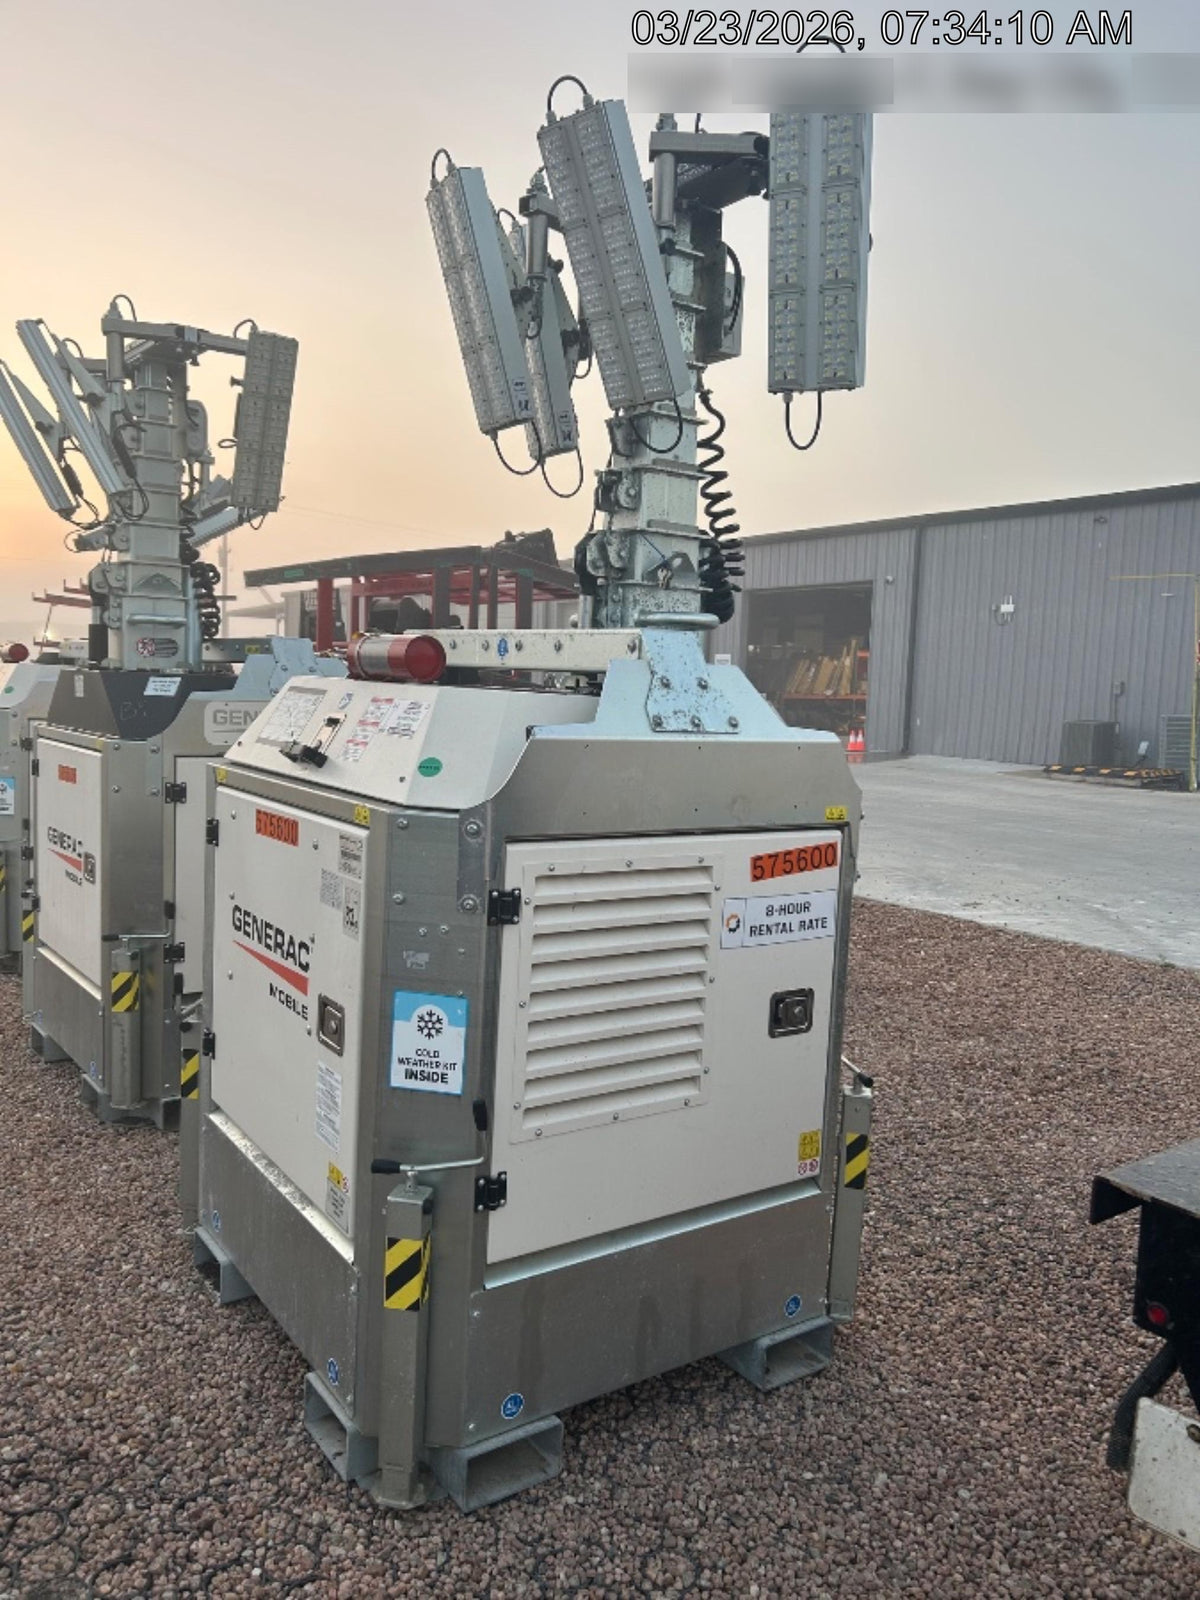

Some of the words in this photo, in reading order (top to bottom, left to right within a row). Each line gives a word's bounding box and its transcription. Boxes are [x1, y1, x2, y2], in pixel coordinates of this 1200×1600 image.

[752, 843, 837, 881] 575600
[765, 901, 812, 917] 8-HOUR
[749, 920, 794, 938] RENTAL
[799, 916, 828, 932] RATE
[231, 904, 310, 973] GENERAC
[268, 982, 309, 1021] MOBILE
[415, 1048, 440, 1059] COLD
[397, 1056, 441, 1070] WEATHER
[442, 1061, 458, 1071] KIT
[404, 1067, 449, 1084] INSIDE
